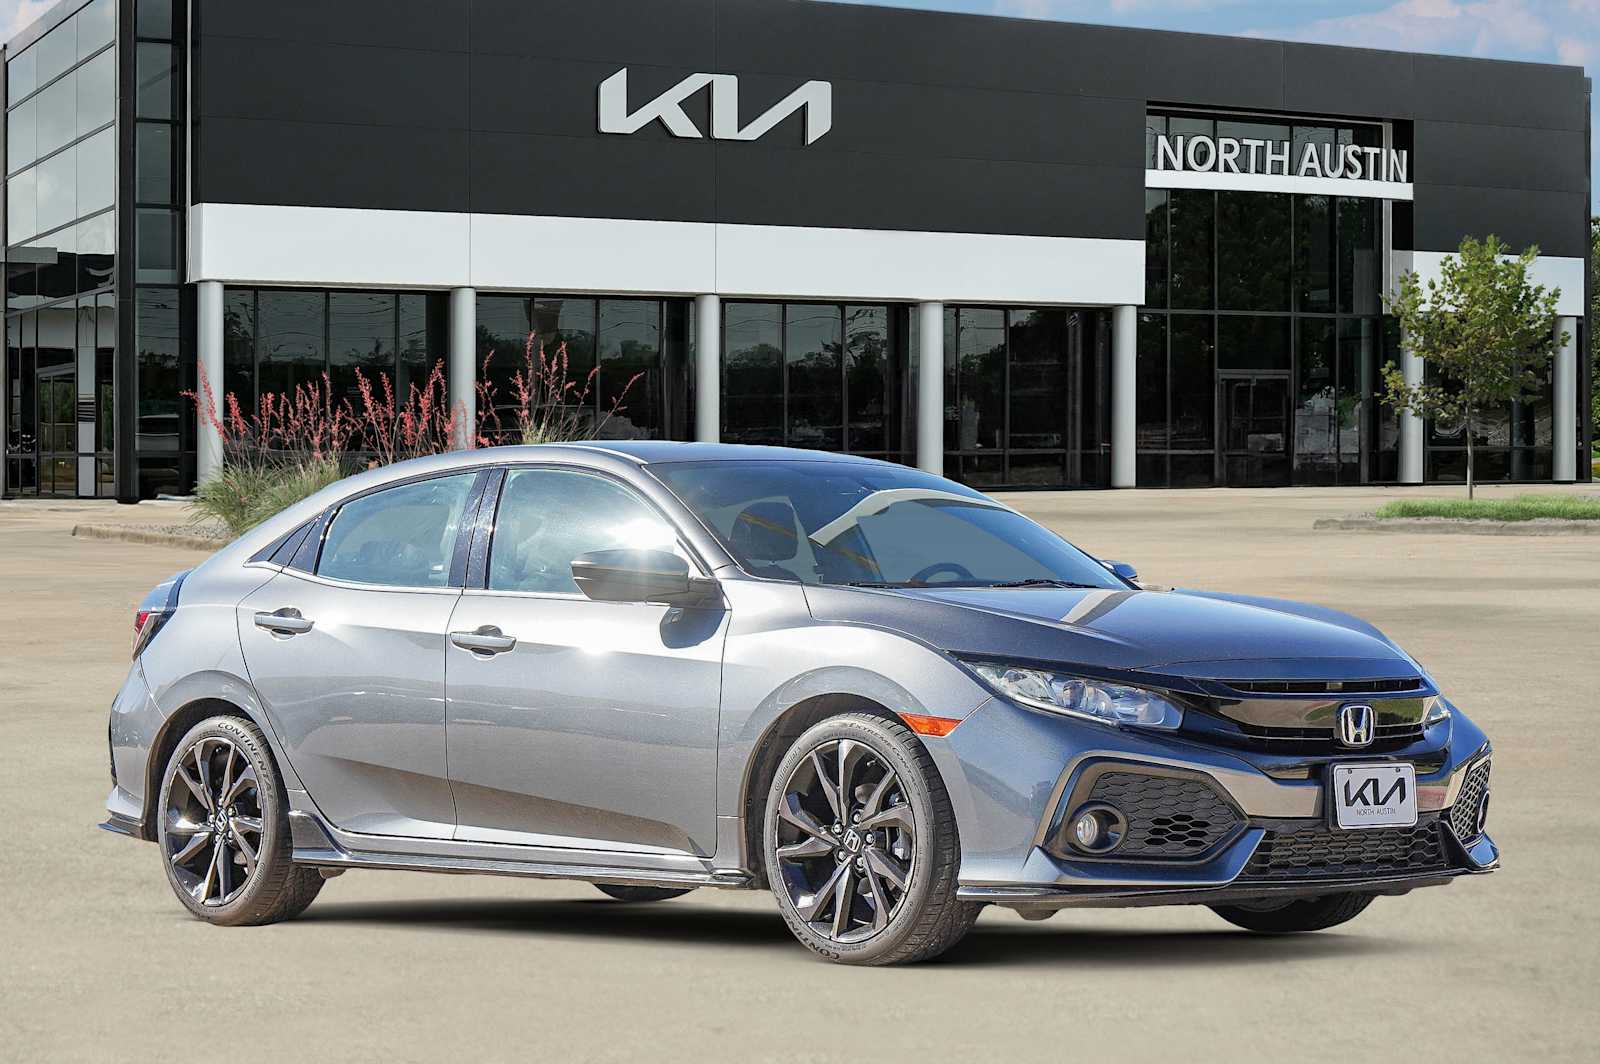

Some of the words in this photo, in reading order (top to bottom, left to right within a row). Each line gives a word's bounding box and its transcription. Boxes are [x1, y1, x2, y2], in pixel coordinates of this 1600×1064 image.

[1156, 134, 1290, 176] NORTH
[1296, 142, 1408, 184] AUSTIN
[1356, 808, 1375, 816] NORTH
[1376, 807, 1396, 815] AUSTIN
